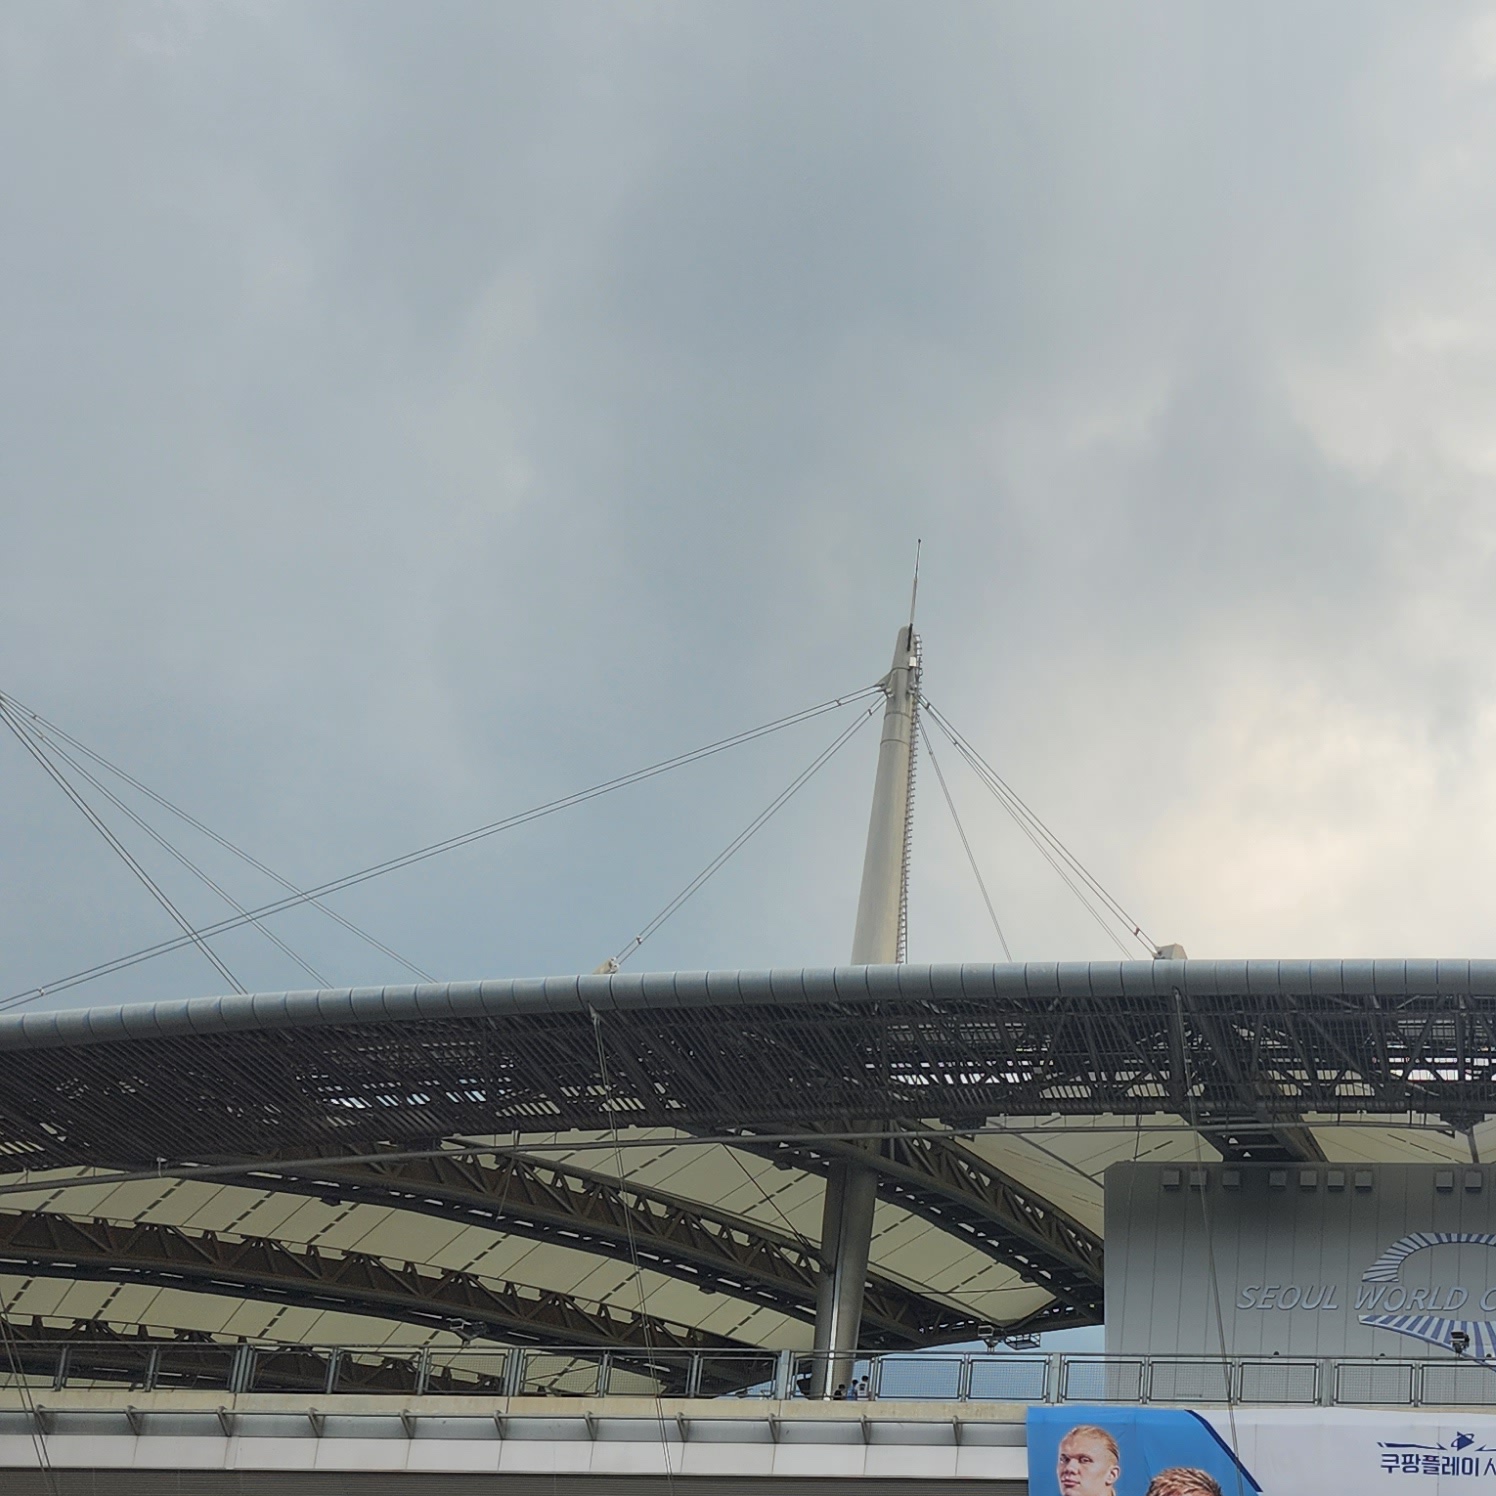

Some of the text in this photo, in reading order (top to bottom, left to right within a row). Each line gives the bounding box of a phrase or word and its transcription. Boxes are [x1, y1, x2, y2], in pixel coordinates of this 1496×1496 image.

[1236, 1284, 1339, 1311] SEOUL
[1353, 1285, 1469, 1312] WORLD
[1380, 1453, 1480, 1477] 쿠팡플레이
